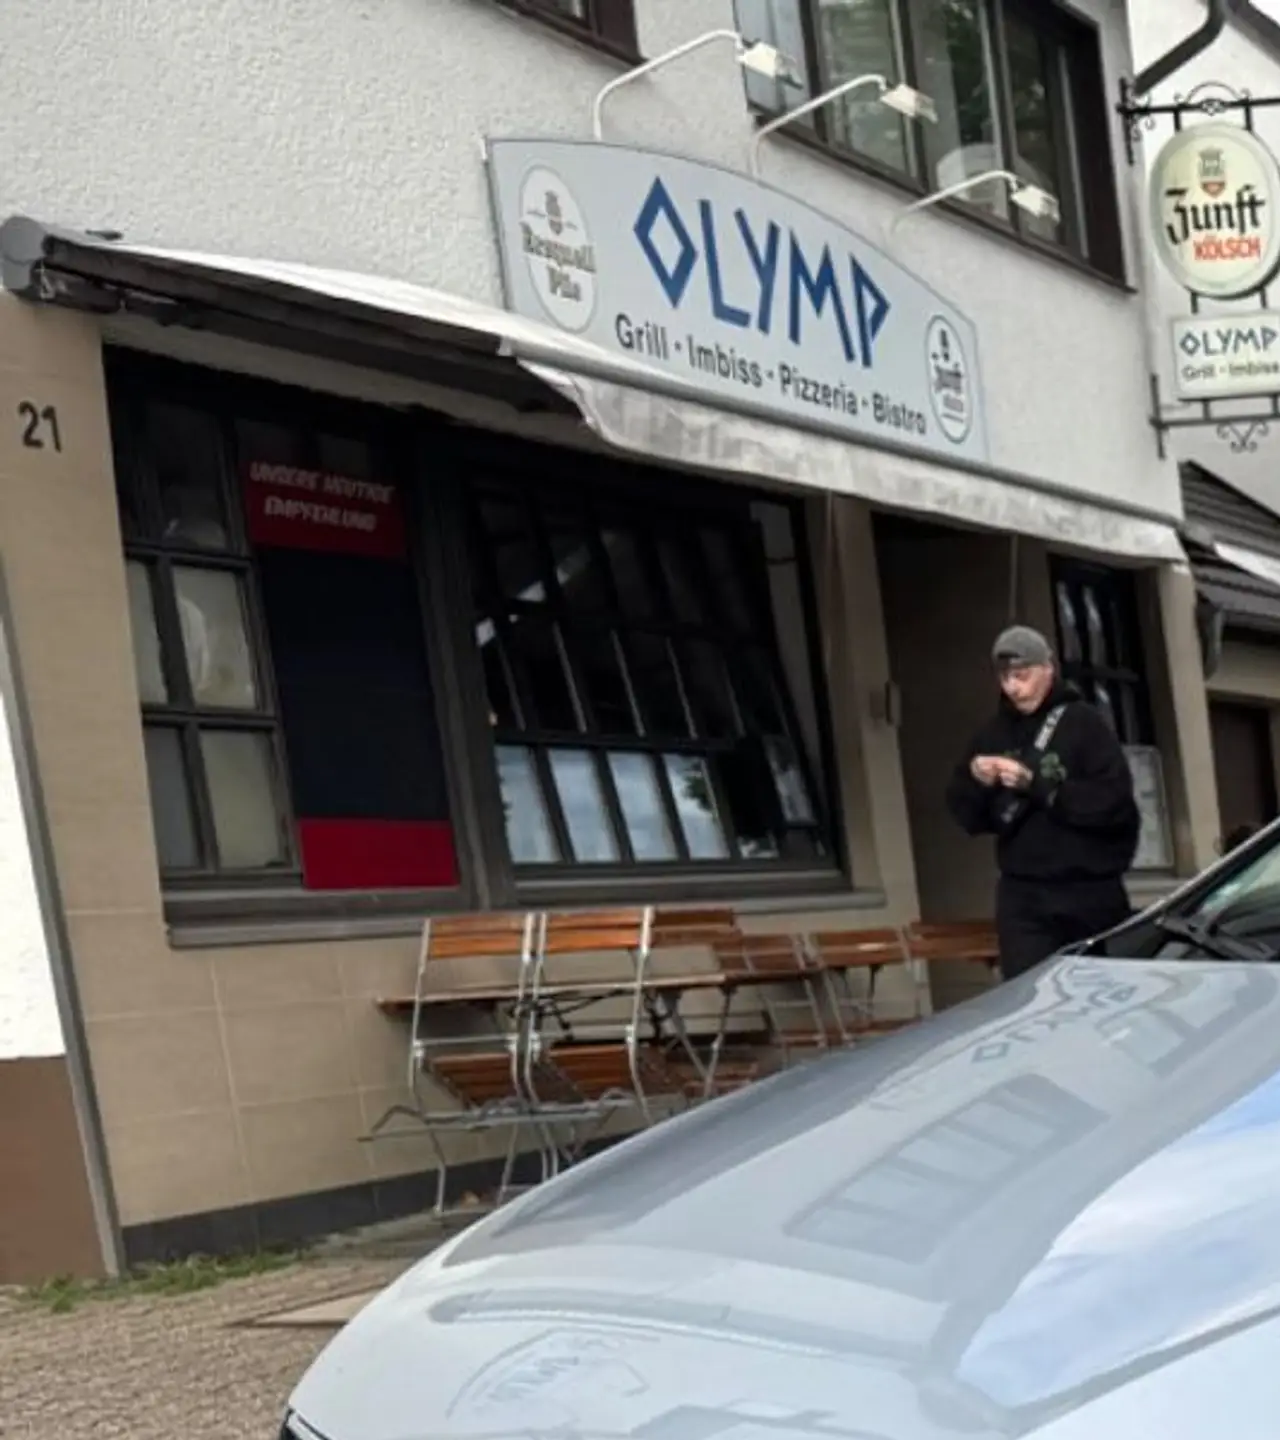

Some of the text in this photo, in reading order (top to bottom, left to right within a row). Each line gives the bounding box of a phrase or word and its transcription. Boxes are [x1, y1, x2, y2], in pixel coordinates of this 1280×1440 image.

[1193, 236, 1262, 261] KÖLSCH
[632, 175, 891, 368] OLYMP
[1179, 326, 1278, 357] OLYMP
[615, 312, 668, 360] Grill
[688, 333, 763, 389] Imbiss
[779, 363, 859, 416] Pizzeria
[872, 393, 927, 437] Bistro
[18, 401, 62, 453] 21
[249, 460, 321, 490] UNSERE
